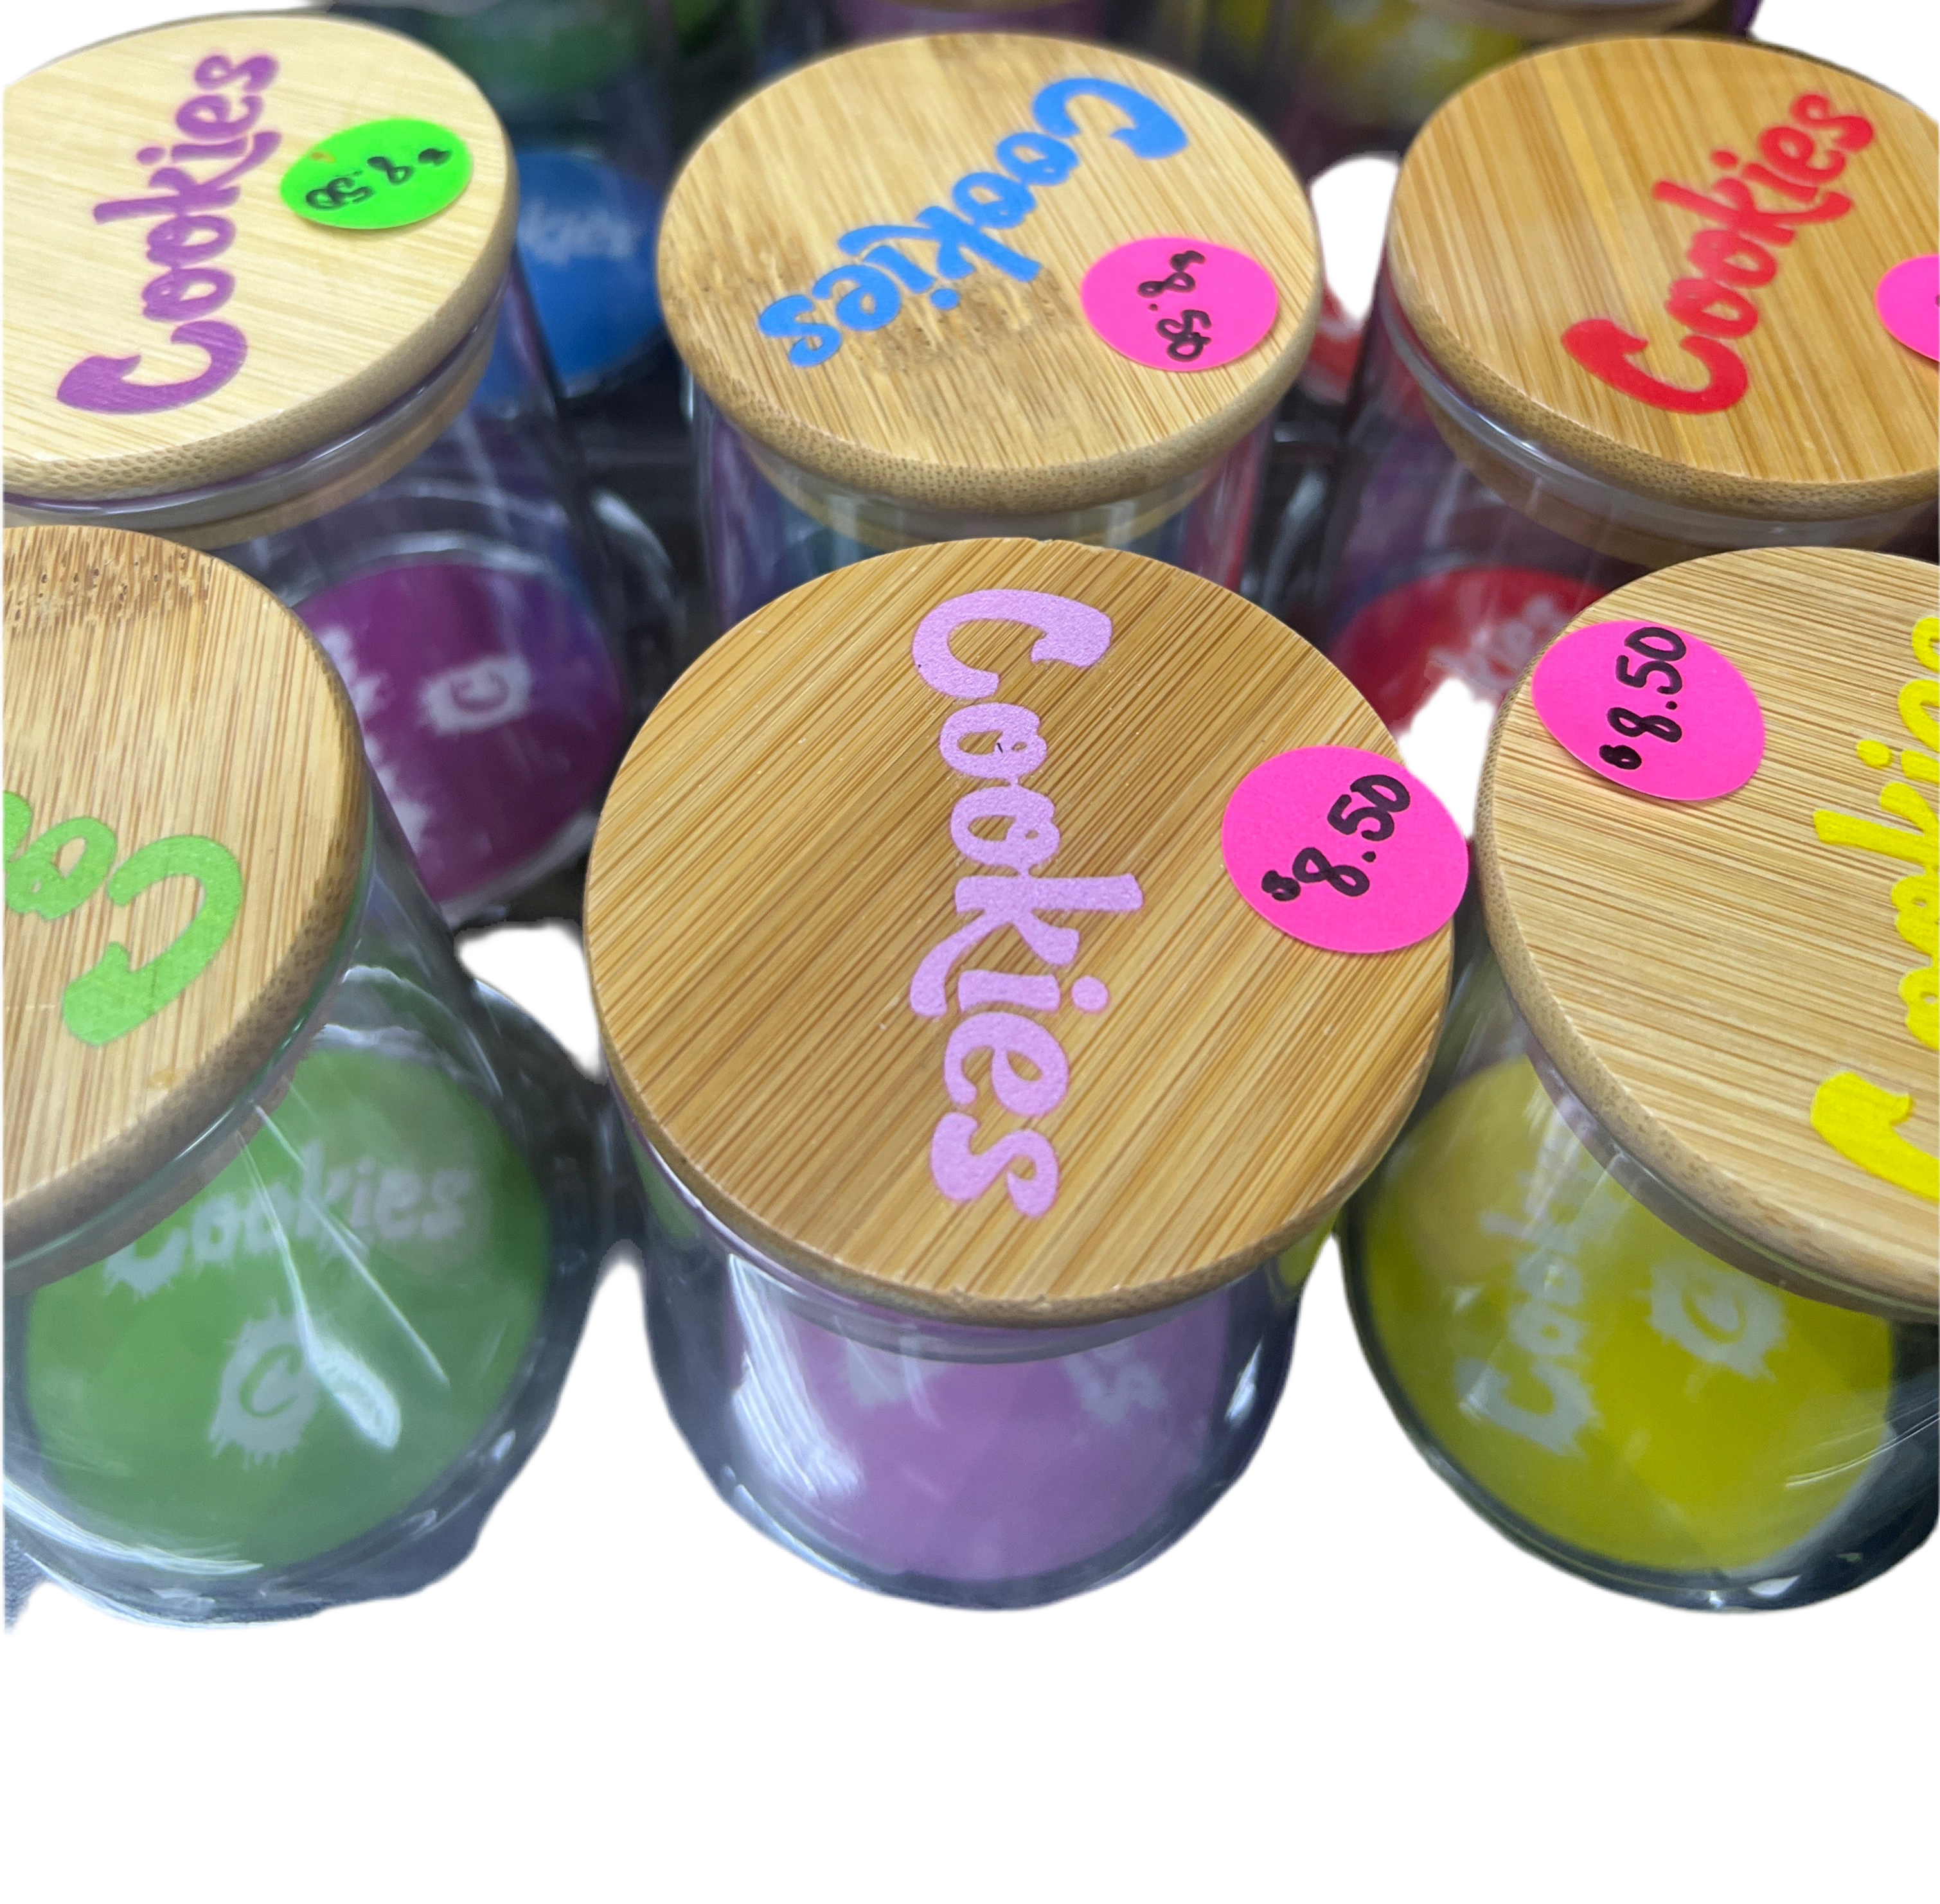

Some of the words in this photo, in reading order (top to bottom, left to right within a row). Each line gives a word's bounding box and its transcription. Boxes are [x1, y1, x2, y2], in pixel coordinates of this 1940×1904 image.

[56, 53, 281, 414] Cookies
[757, 76, 1188, 368] Cookies
[1560, 93, 1876, 414] Cookies
[909, 588, 1144, 1218] Cookies
